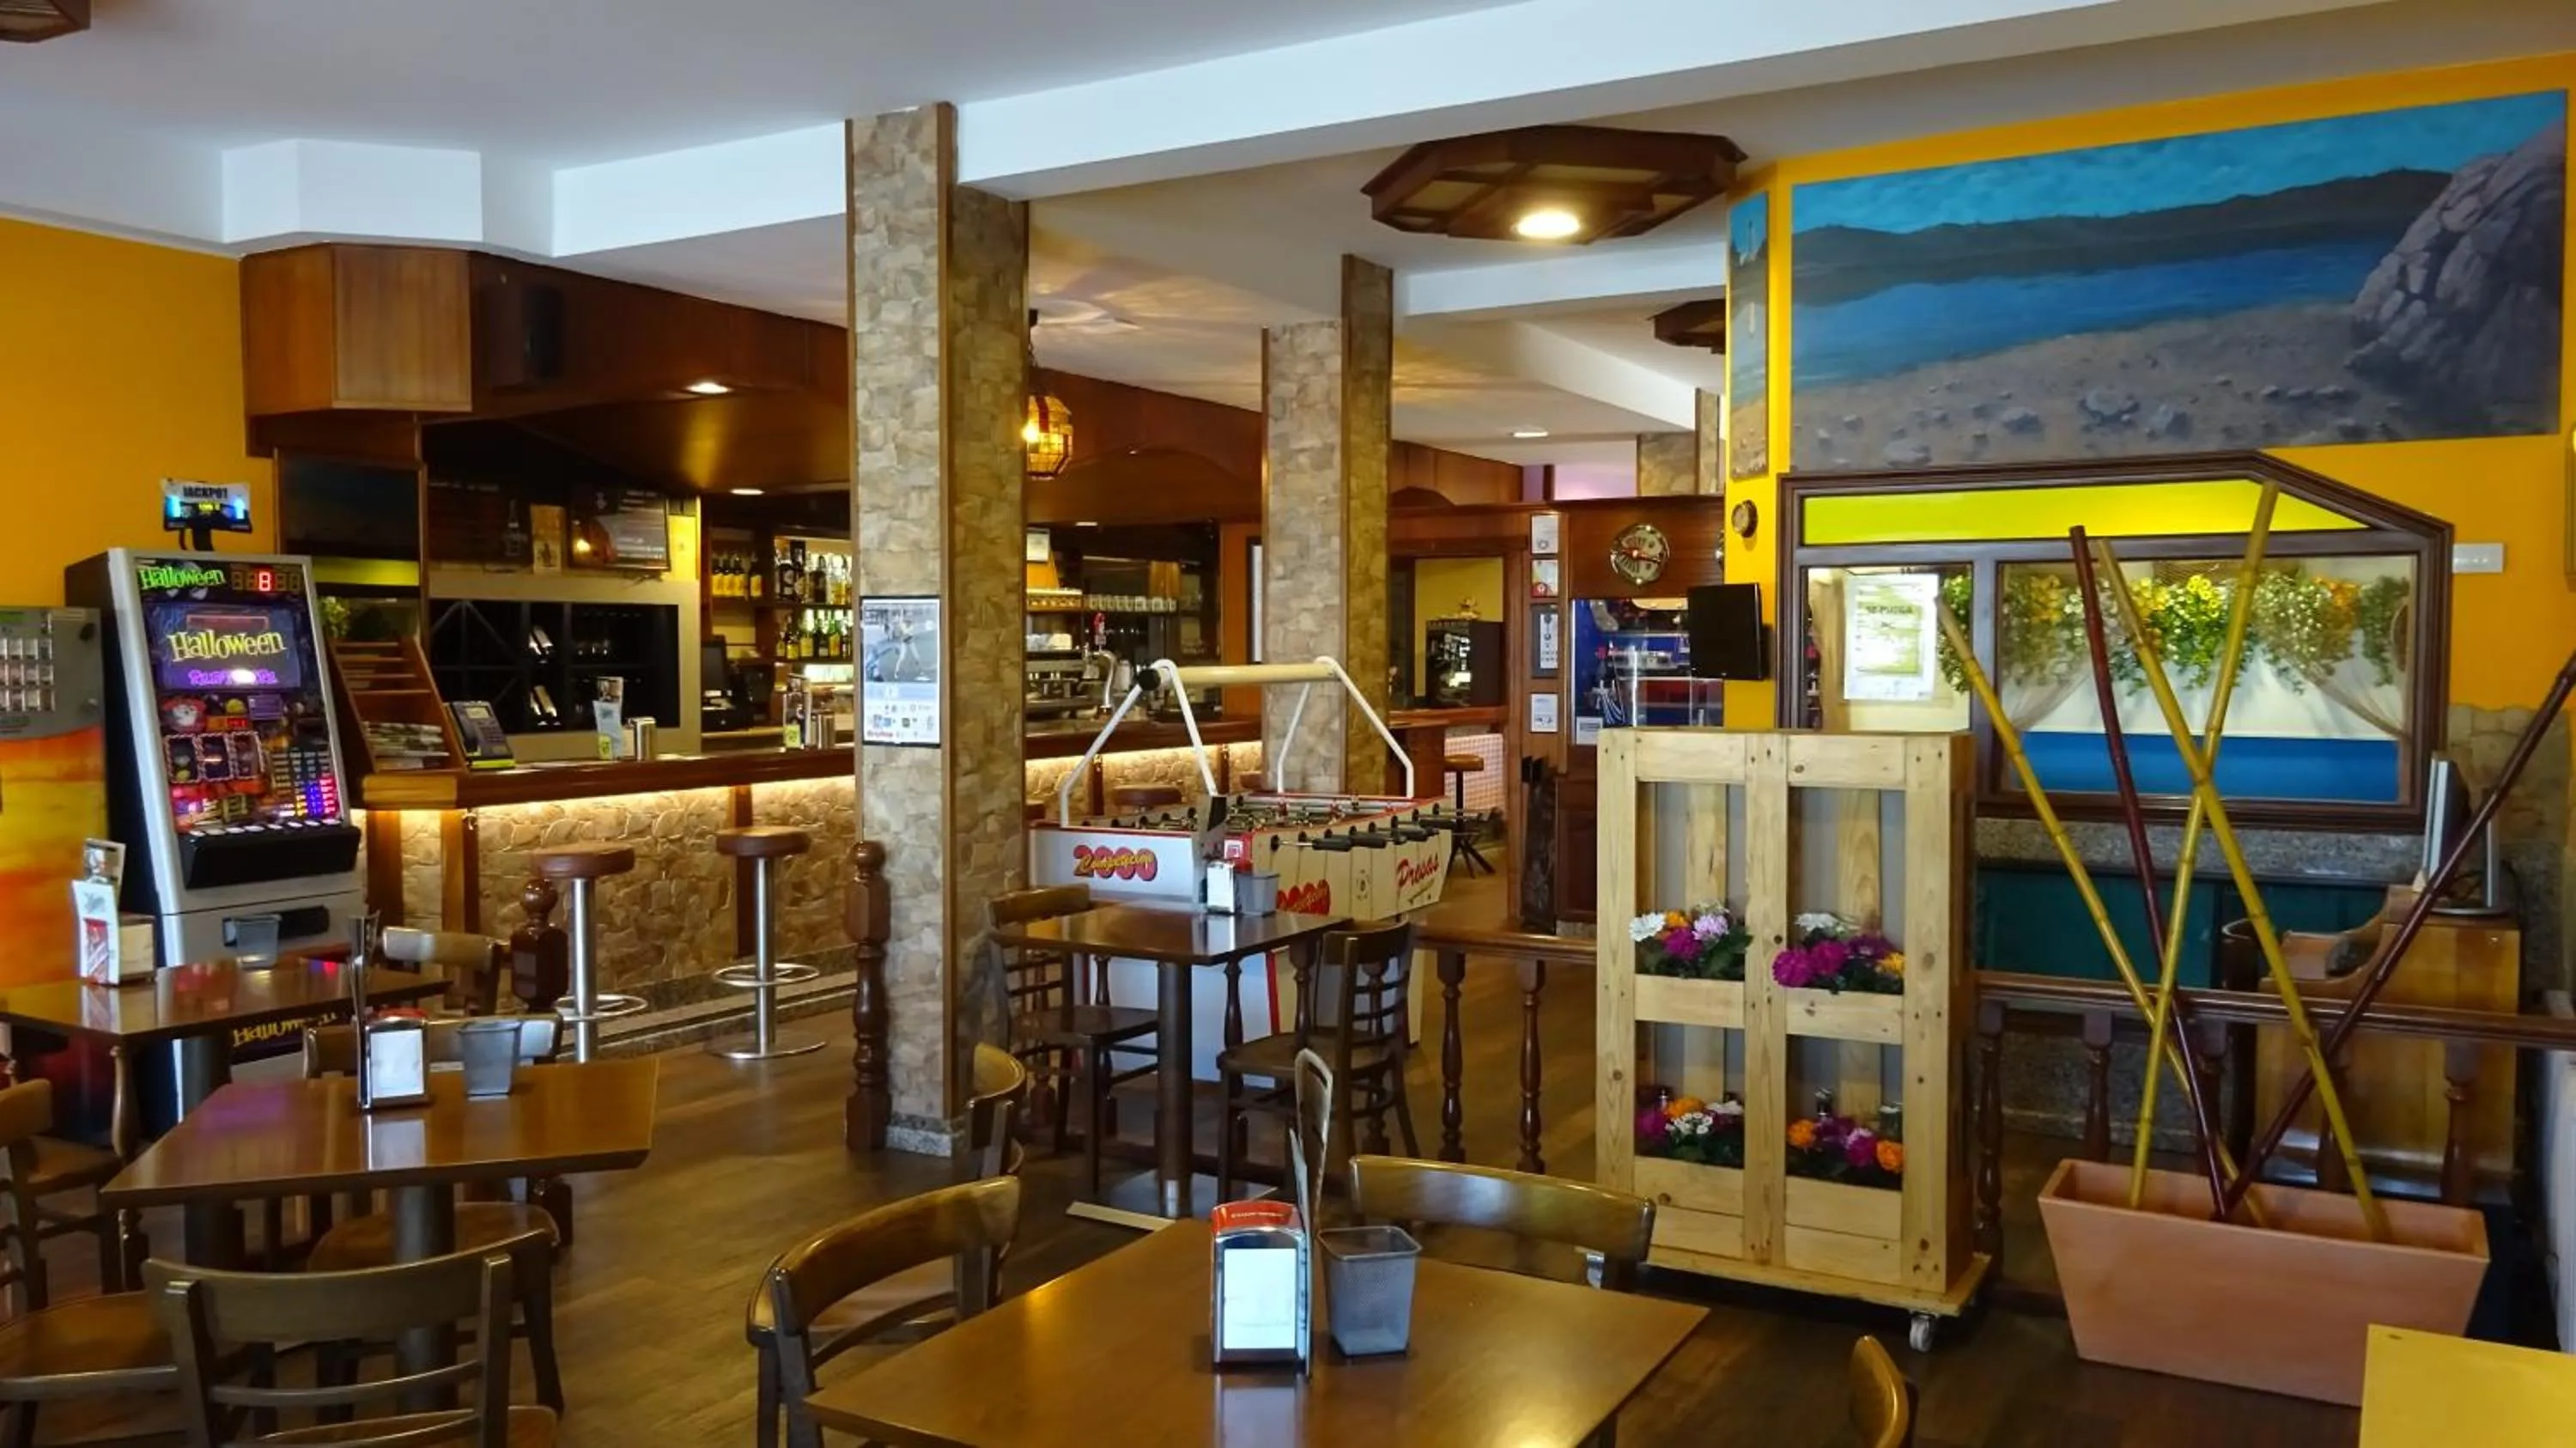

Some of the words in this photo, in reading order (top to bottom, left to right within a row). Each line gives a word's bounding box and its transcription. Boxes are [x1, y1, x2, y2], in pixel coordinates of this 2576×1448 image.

[183, 485, 228, 499] JACKPOT
[139, 567, 224, 590] Halloween
[167, 629, 289, 662] Halloween
[1073, 845, 1157, 882] 2000
[1396, 850, 1439, 888] Presas
